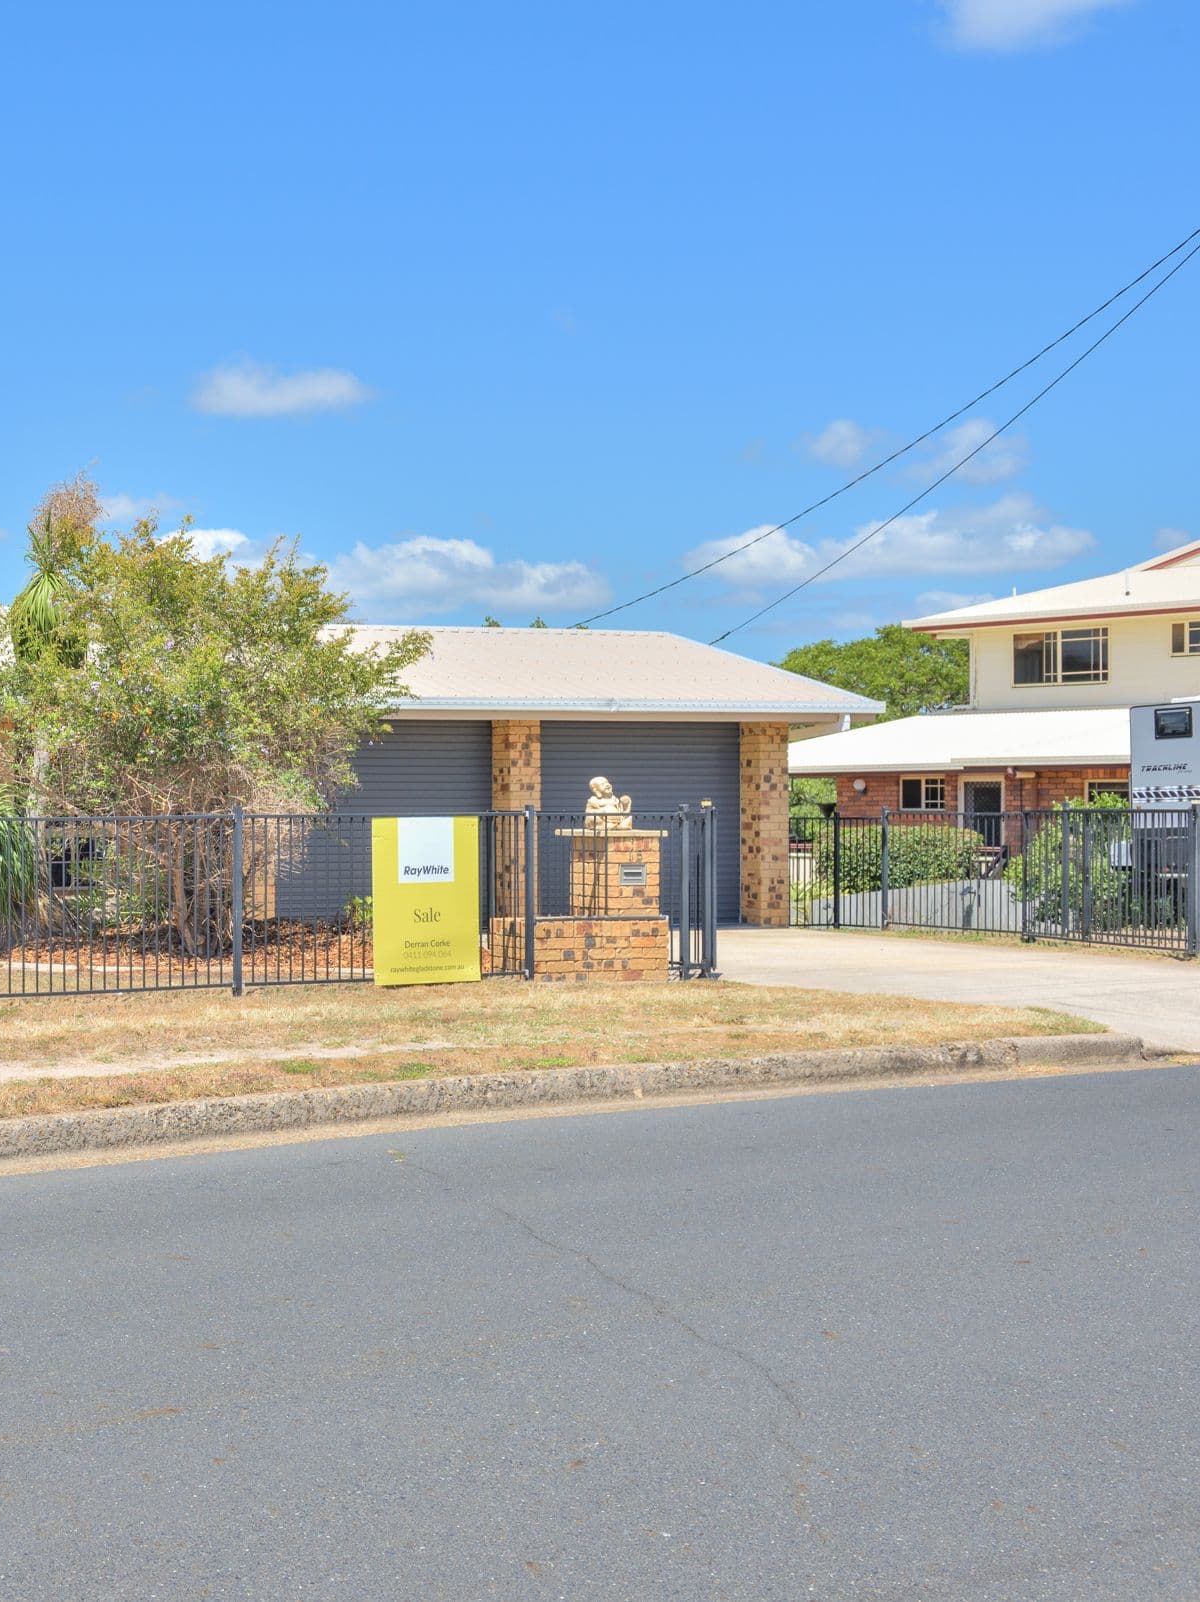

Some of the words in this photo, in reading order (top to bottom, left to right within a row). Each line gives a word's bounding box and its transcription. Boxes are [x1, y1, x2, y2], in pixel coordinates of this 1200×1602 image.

[413, 907, 441, 923] Sale
[404, 940, 429, 949] Derran
[430, 939, 451, 948] Corke
